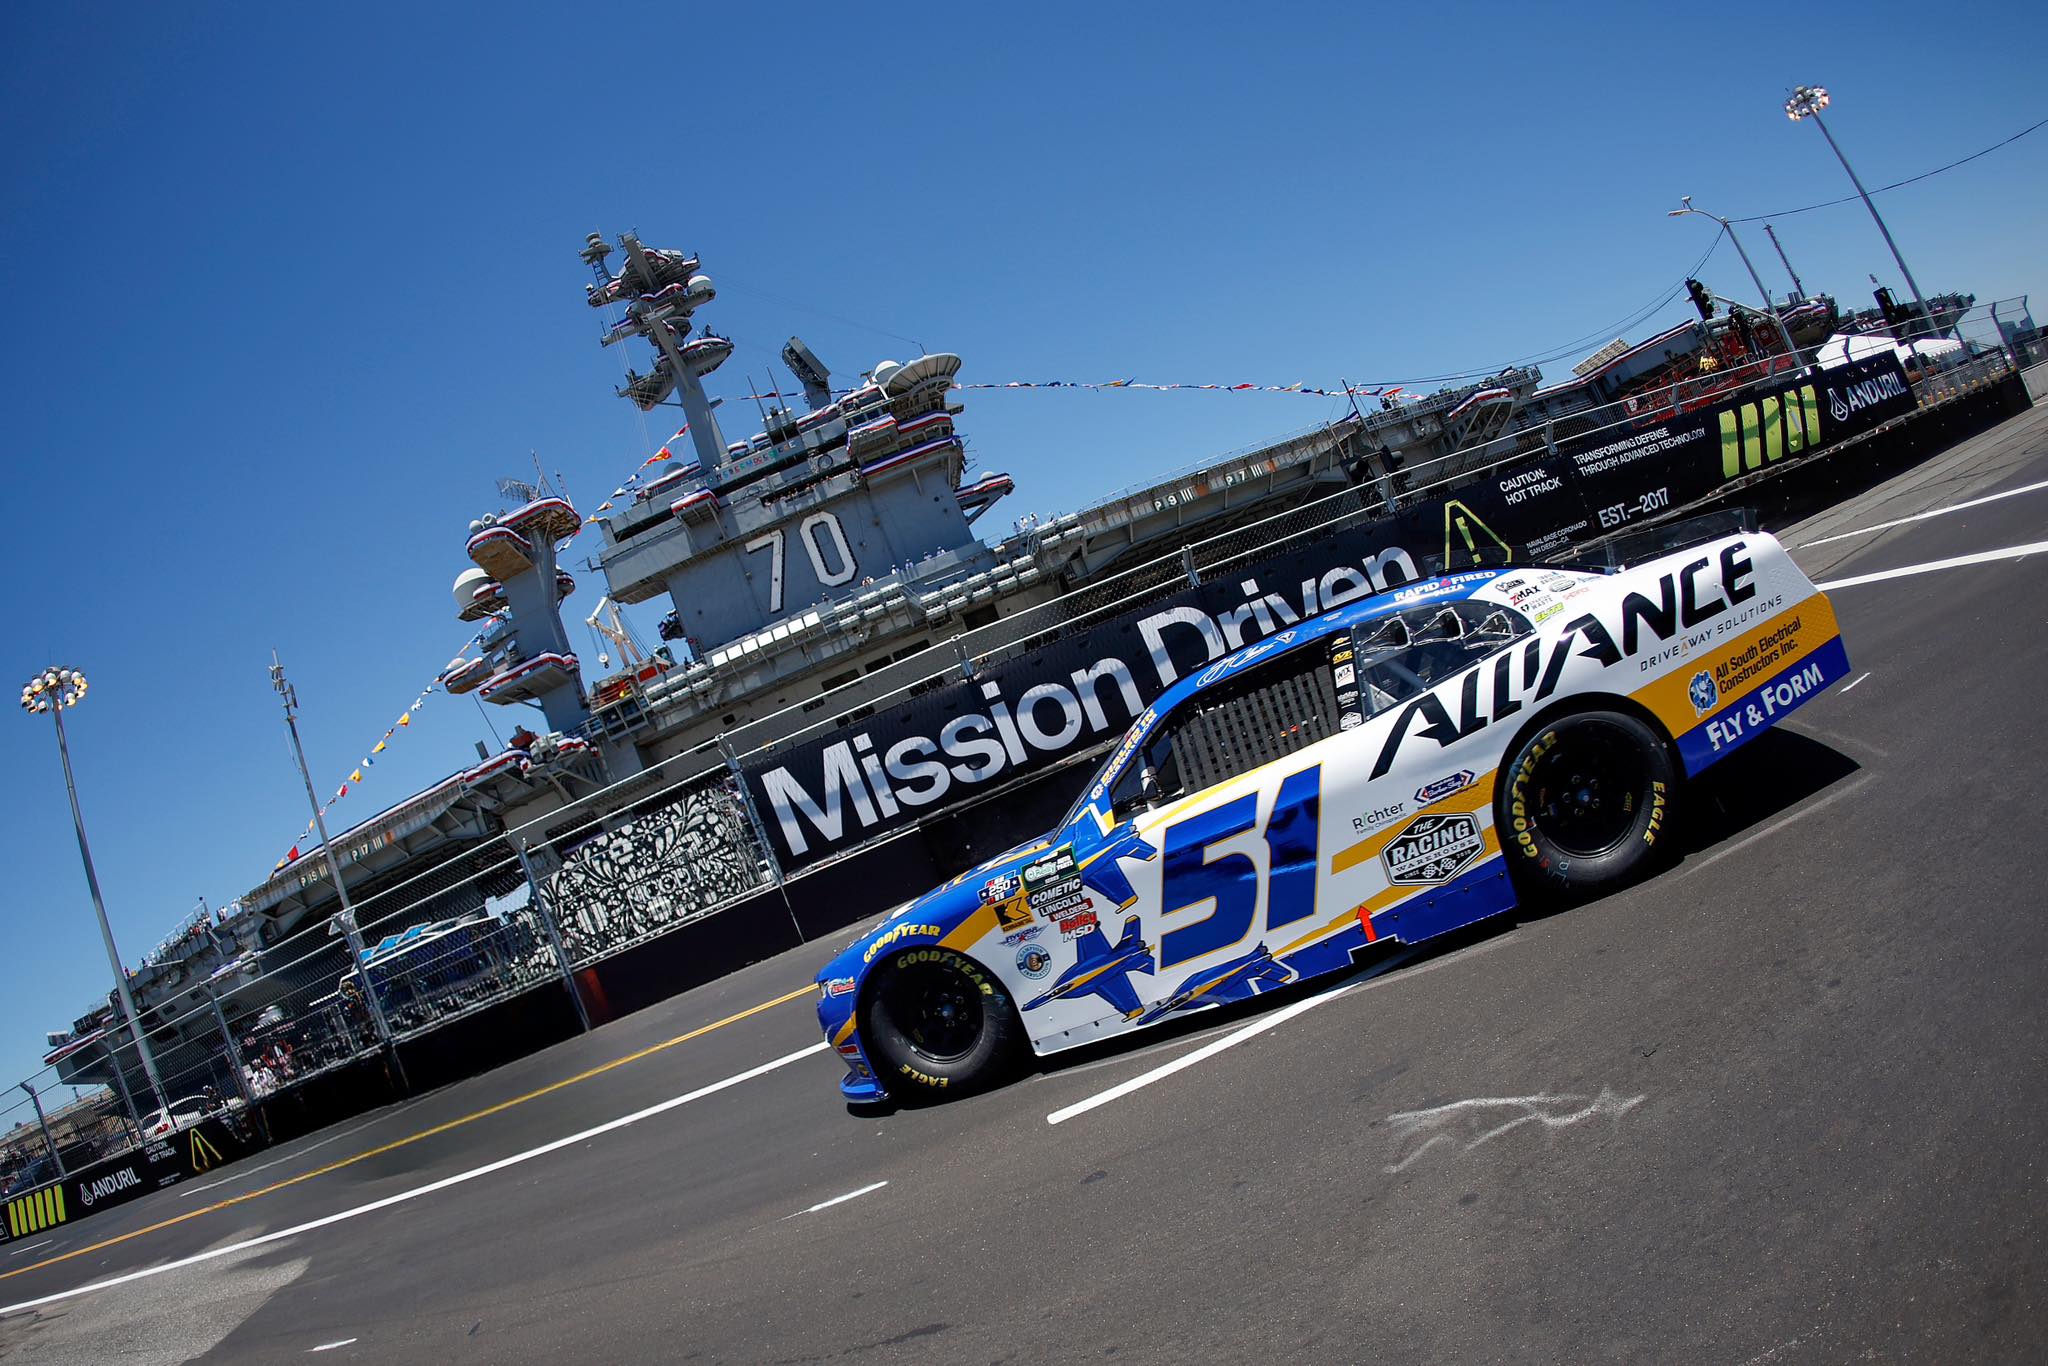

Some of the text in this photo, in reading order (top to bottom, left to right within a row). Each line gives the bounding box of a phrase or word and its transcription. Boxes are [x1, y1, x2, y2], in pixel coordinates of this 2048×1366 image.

[1848, 371, 1907, 412] ANDURIL
[1573, 427, 1670, 466] TRANSFORMING DEFENSE
[1579, 426, 1706, 478] THROUGH ADVANCED TECHNOLOGY
[1499, 468, 1547, 492] CAUTION:
[1505, 477, 1563, 506] HOT TRACK
[1526, 520, 1588, 550] NAVAL BASE CORONADO
[1529, 545, 1543, 557] SAN
[745, 511, 858, 614] 70
[1393, 571, 1497, 602] RAPID FIRED
[1640, 594, 1783, 672] DRIVEAWAY SOLUTIONS
[1715, 615, 1802, 681] All South Electrical
[1336, 665, 1352, 680] WIX
[1368, 541, 1756, 782] ALLIANCE
[1719, 638, 1798, 694] Constructors Inc.
[761, 547, 1420, 857] Mission Driven
[1705, 662, 1825, 751] FLY & FORM
[1512, 730, 1558, 858] GOODYEAR
[1352, 802, 1404, 830] Richter
[1413, 818, 1435, 835] THE
[1643, 780, 1666, 846] EAGLE
[1391, 820, 1470, 866] RACING
[1396, 838, 1475, 873] WAREHOUSE
[1160, 761, 1323, 971] 51
[1404, 849, 1472, 879] SINCE 2010
[988, 879, 1011, 896] 250
[1031, 878, 1081, 905] COMETIC
[1040, 894, 1082, 916] LINCOLN
[1052, 903, 1089, 920] WELDERS
[863, 921, 941, 964] GOODYEAR
[1062, 923, 1096, 943] MSD
[1017, 945, 1044, 961] CHAMPION
[896, 950, 994, 996] GOODYEAR
[899, 1063, 950, 1088] EAGLE
[159, 1146, 177, 1159] TRACK
[91, 1166, 141, 1199] ANDURIL
